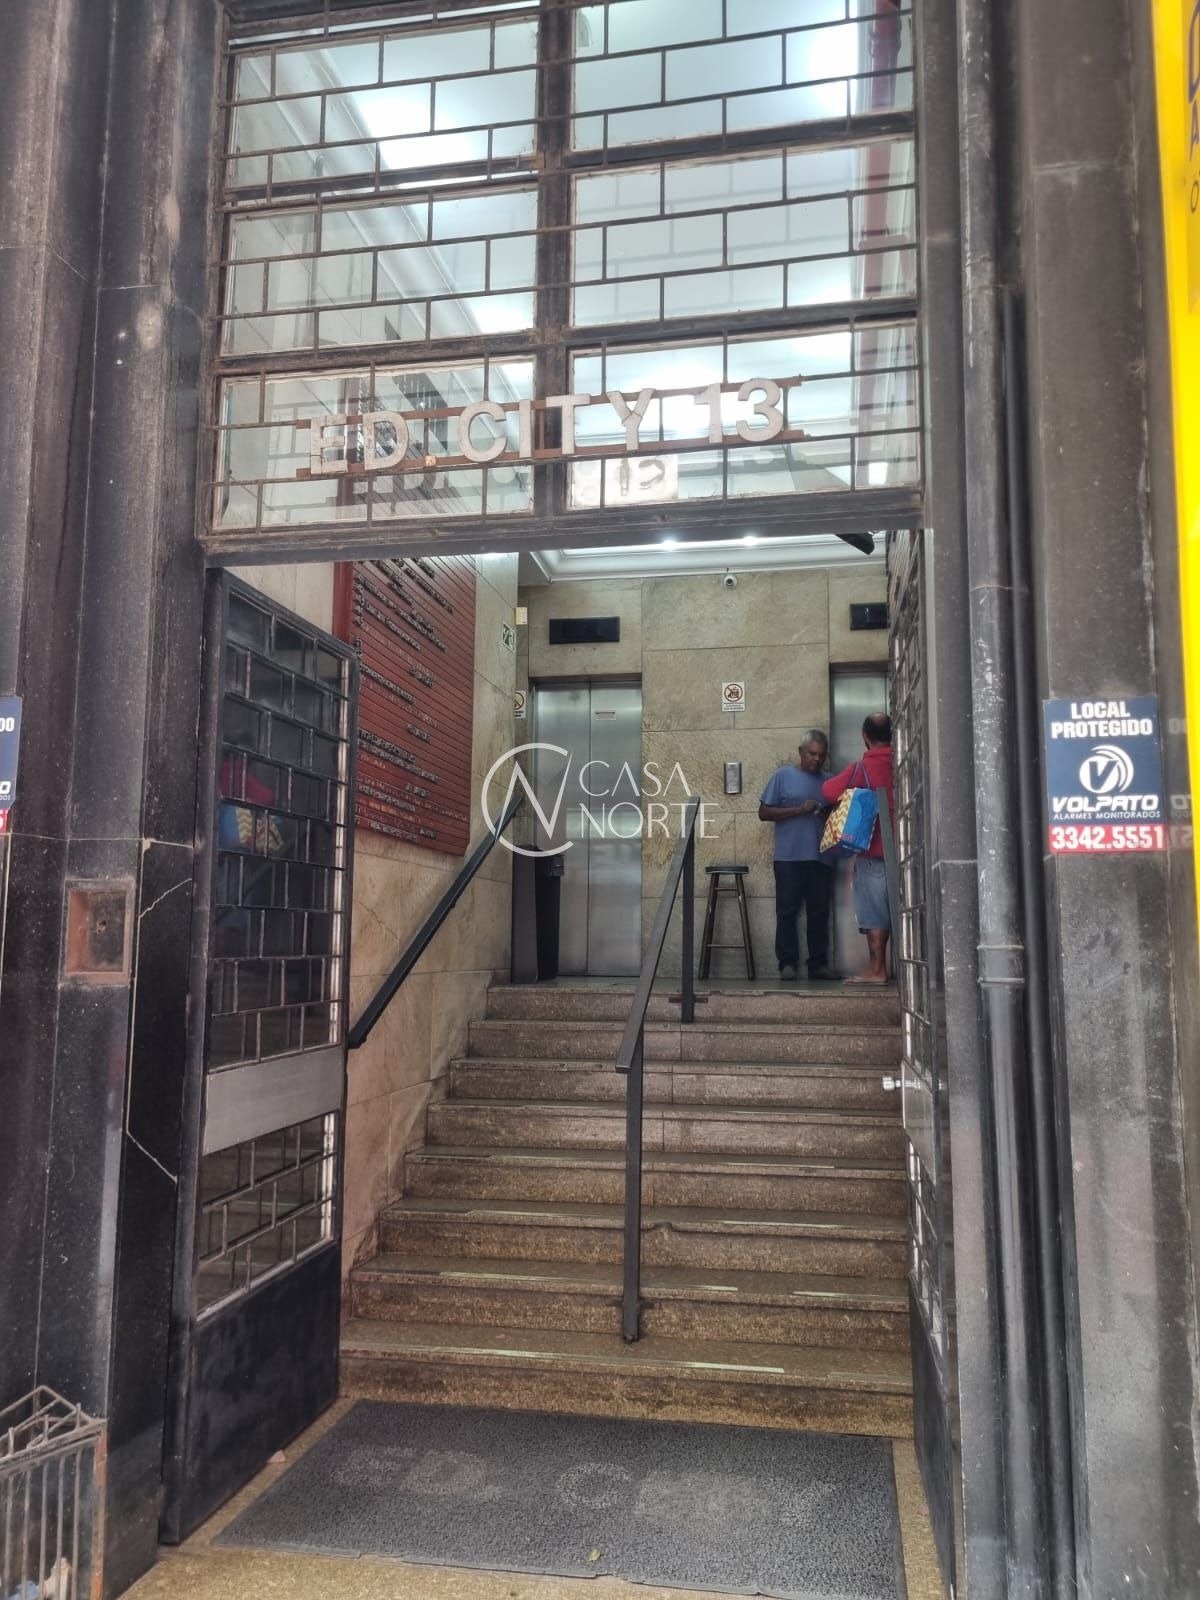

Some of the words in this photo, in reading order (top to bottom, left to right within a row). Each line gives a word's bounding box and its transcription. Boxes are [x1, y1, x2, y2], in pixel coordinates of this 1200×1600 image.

[458, 388, 655, 462] CITY
[694, 378, 784, 443] 13
[1071, 701, 1130, 719] LOCAL
[1051, 718, 1153, 739] PROTEGIDO
[1051, 794, 1159, 813] VOLPATO
[1053, 812, 1093, 821] ALARMES
[1095, 810, 1161, 820] MONITORADOS
[1051, 825, 1164, 850] 3342.5551
